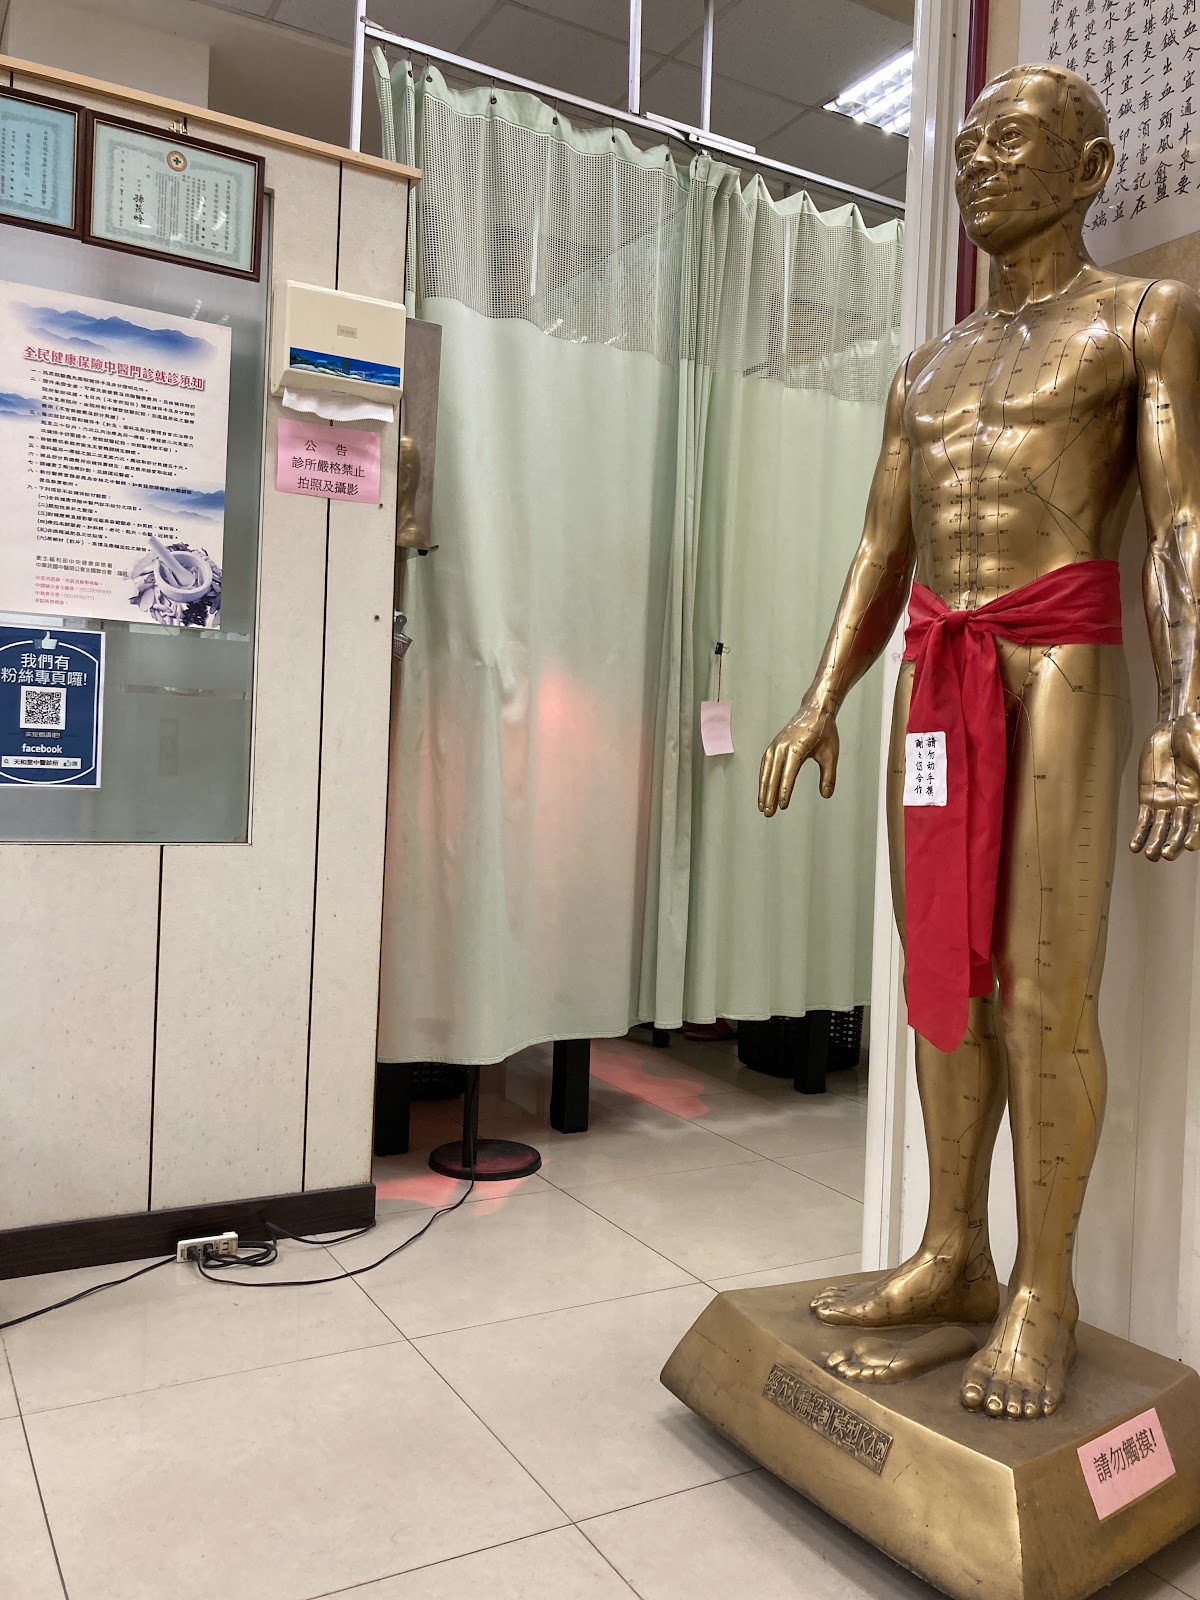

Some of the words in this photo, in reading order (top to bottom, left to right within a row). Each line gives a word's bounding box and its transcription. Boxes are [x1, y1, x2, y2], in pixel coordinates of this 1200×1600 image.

[23, 346, 205, 390] 全民健康保險中醫門診就診須知
[304, 439, 317, 452] 公
[335, 444, 348, 457] 告
[291, 456, 365, 478] 診所嚴格禁止
[297, 476, 359, 496] 拍照及攝影
[21, 653, 70, 670] 我們有
[1, 667, 88, 687] 粉絲專頁囉!
[22, 743, 63, 754] facebook
[1093, 1427, 1158, 1484] 請勿觸摸!
